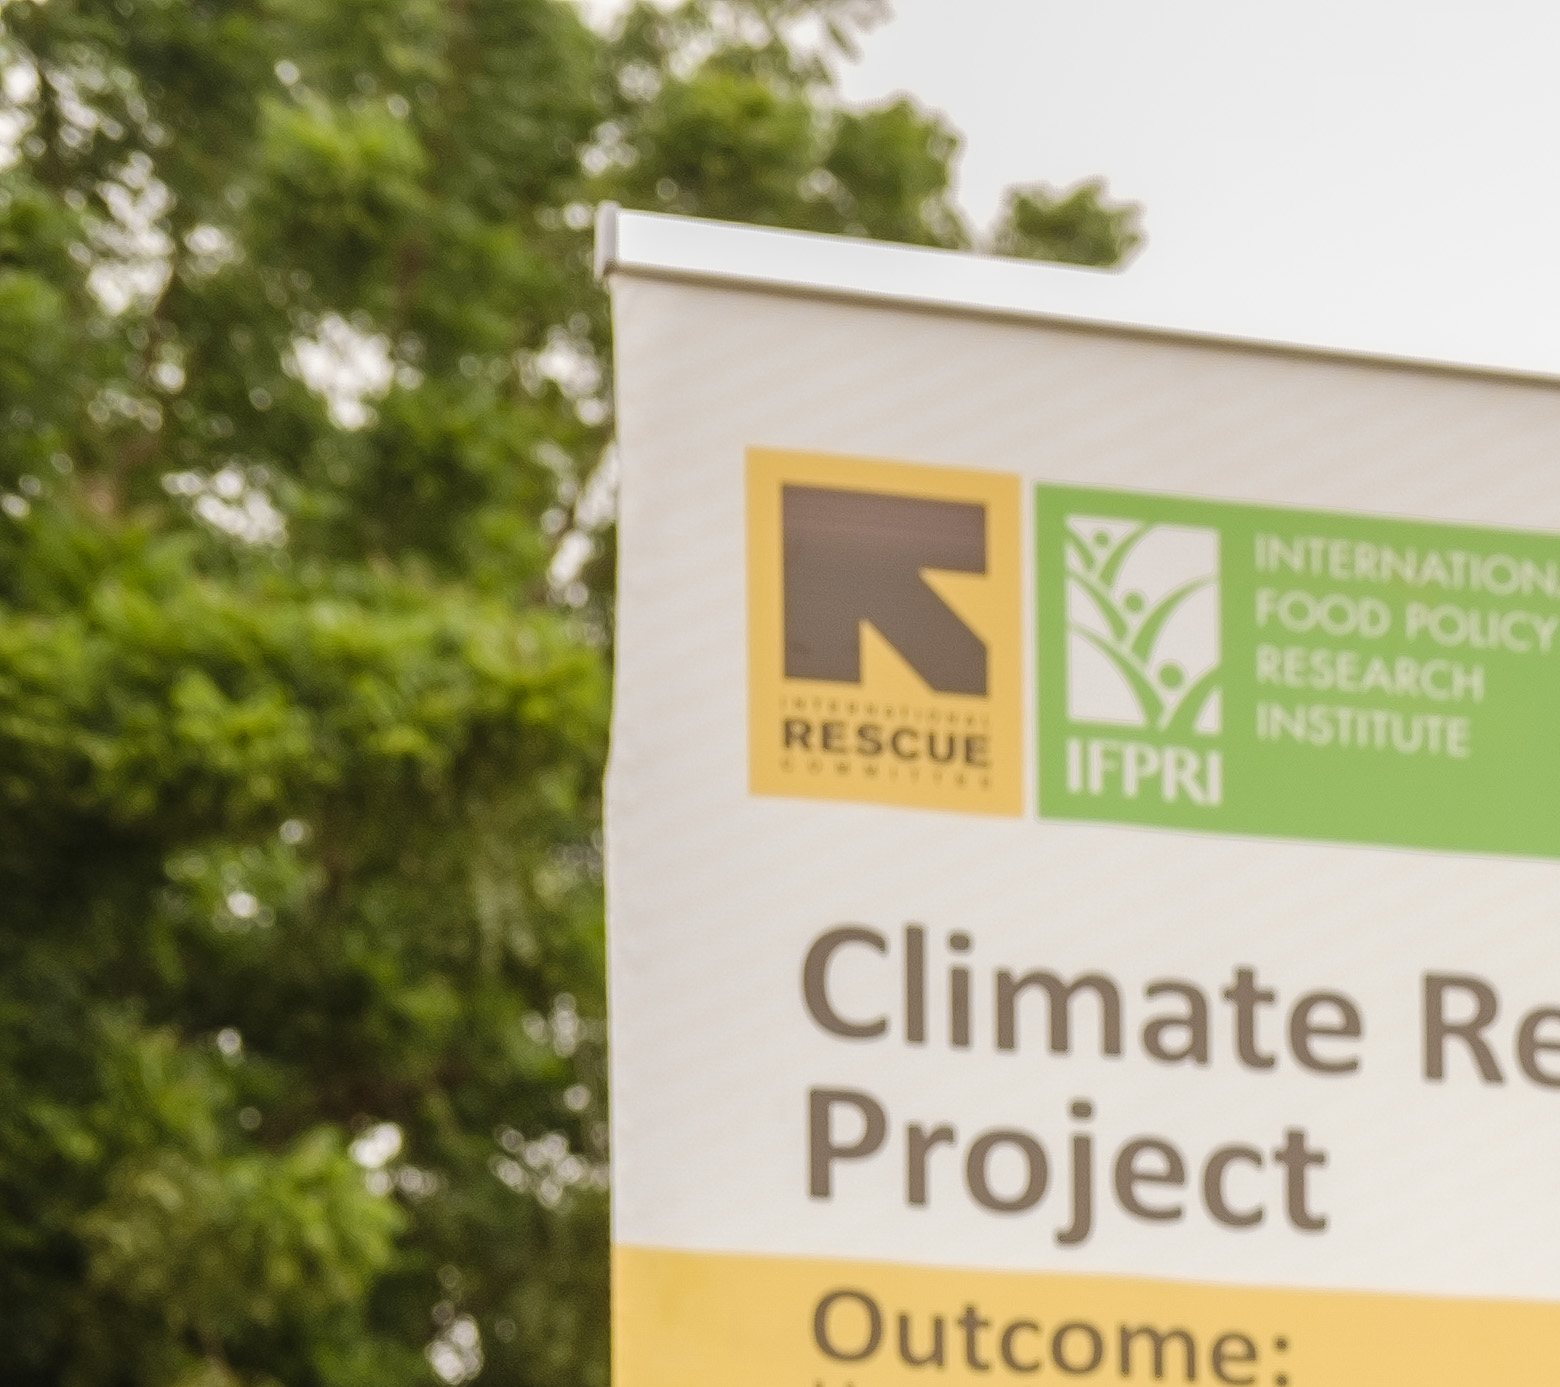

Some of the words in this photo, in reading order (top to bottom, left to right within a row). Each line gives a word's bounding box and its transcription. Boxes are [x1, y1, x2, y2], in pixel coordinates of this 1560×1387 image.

[1255, 588, 1391, 638] FOOD
[1405, 602, 1559, 652] POLICY
[1255, 643, 1486, 704] RESEARCH
[783, 718, 987, 767] RESCUE
[1256, 703, 1468, 758] INSTITUTE
[1067, 738, 1222, 805] IFPRI
[801, 923, 1363, 1076] Climate
[807, 1086, 1327, 1247] Project
